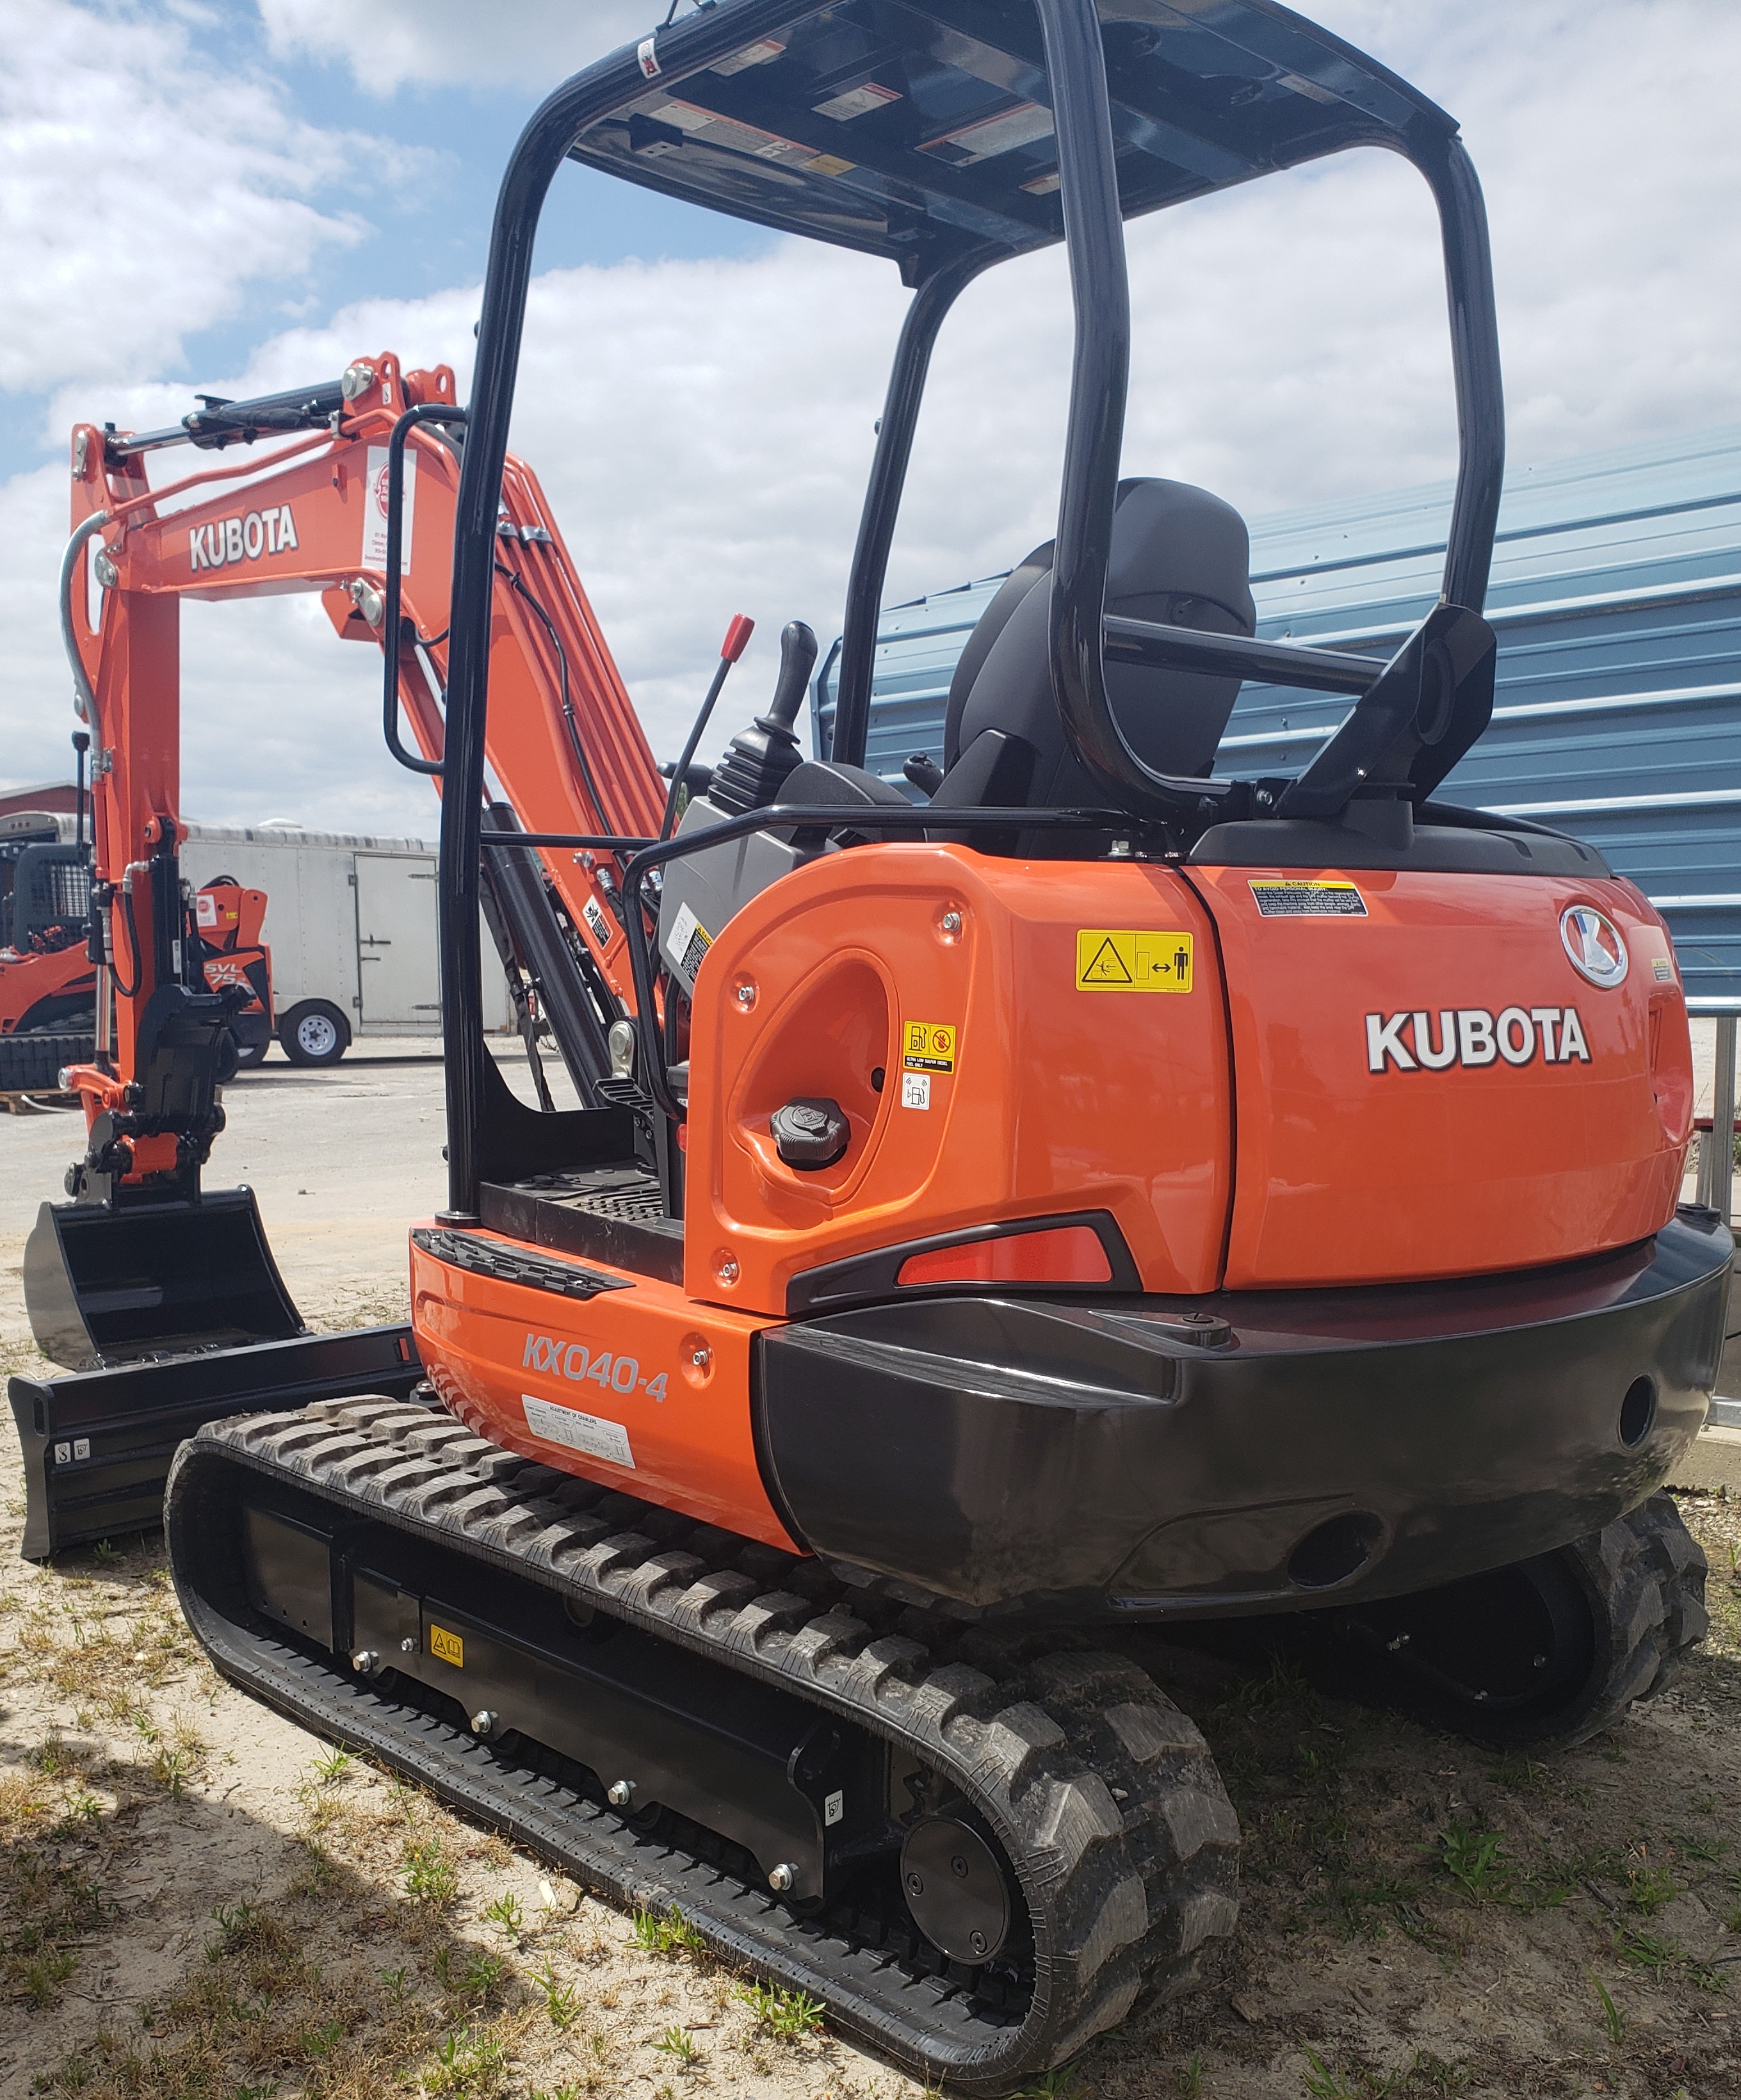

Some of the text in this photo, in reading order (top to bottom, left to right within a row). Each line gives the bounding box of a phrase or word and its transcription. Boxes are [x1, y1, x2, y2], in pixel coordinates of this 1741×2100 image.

[190, 504, 298, 572] KUBOTA
[205, 963, 242, 973] SVL
[1365, 1006, 1591, 1071] KUBOTA
[522, 1334, 668, 1403] KX040-4
[549, 1405, 571, 1416] ADJUSTMENT
[578, 1414, 597, 1425] CRAWLERS
